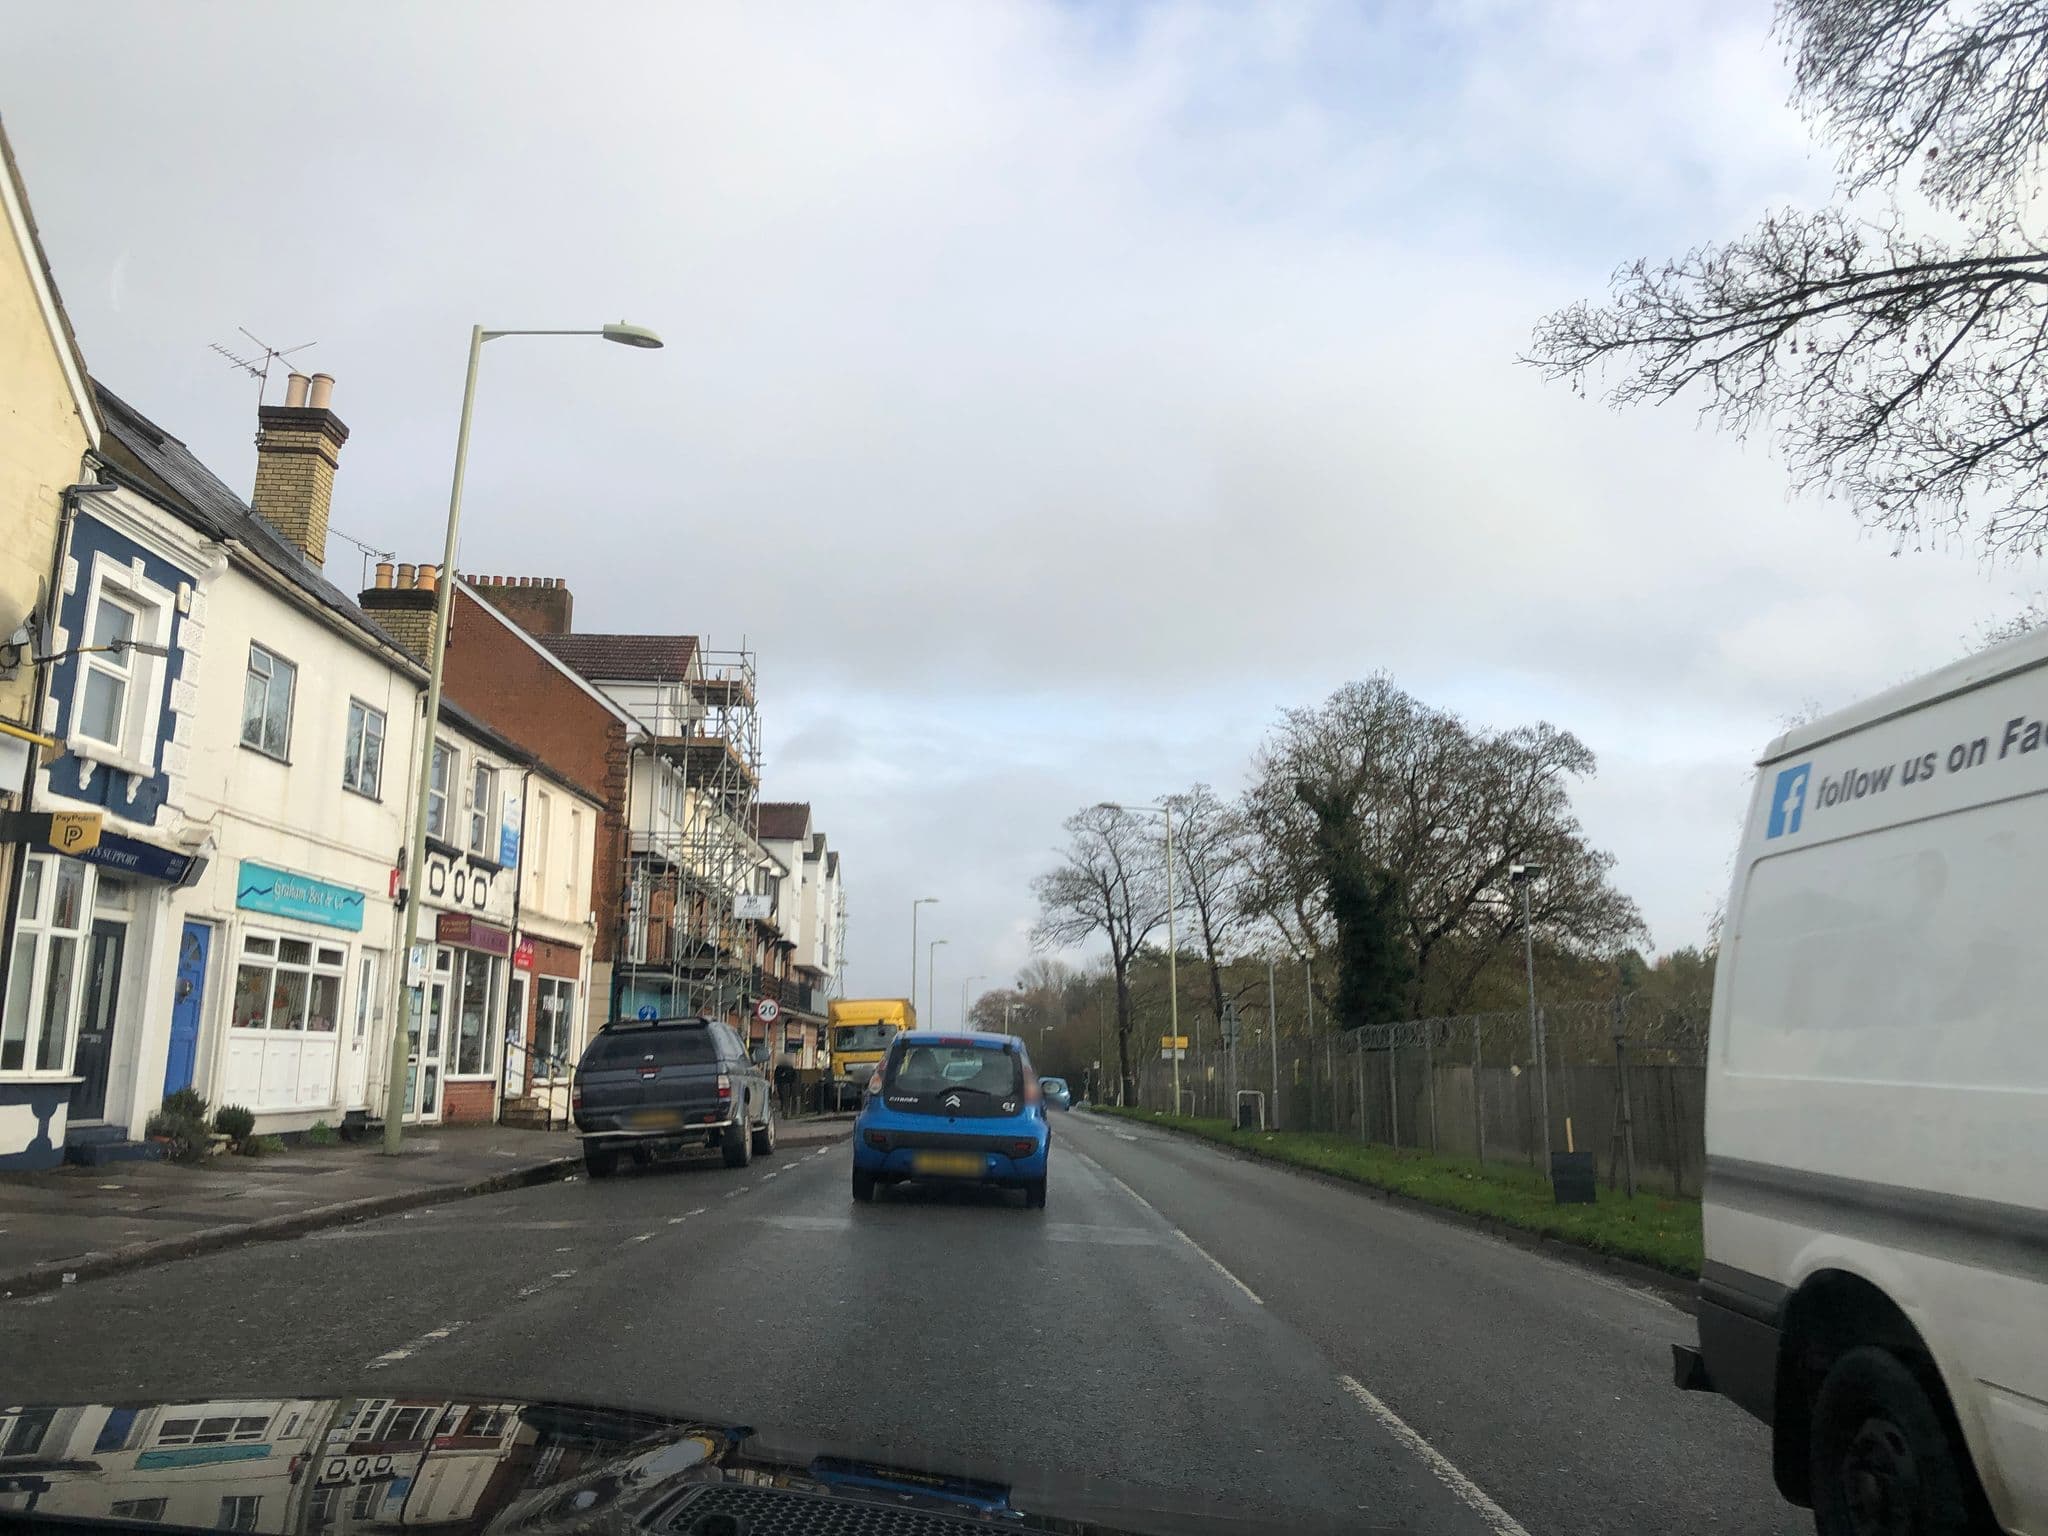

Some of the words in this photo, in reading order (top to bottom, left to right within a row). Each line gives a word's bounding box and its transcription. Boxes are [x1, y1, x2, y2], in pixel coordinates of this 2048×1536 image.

[1815, 764, 1896, 811] follow
[1901, 752, 1938, 787] us
[1947, 736, 1990, 775] on
[1997, 715, 2048, 761] Fa
[55, 814, 97, 823] PayPoint
[102, 848, 140, 867] SUPPORT
[760, 1005, 776, 1016] 20
